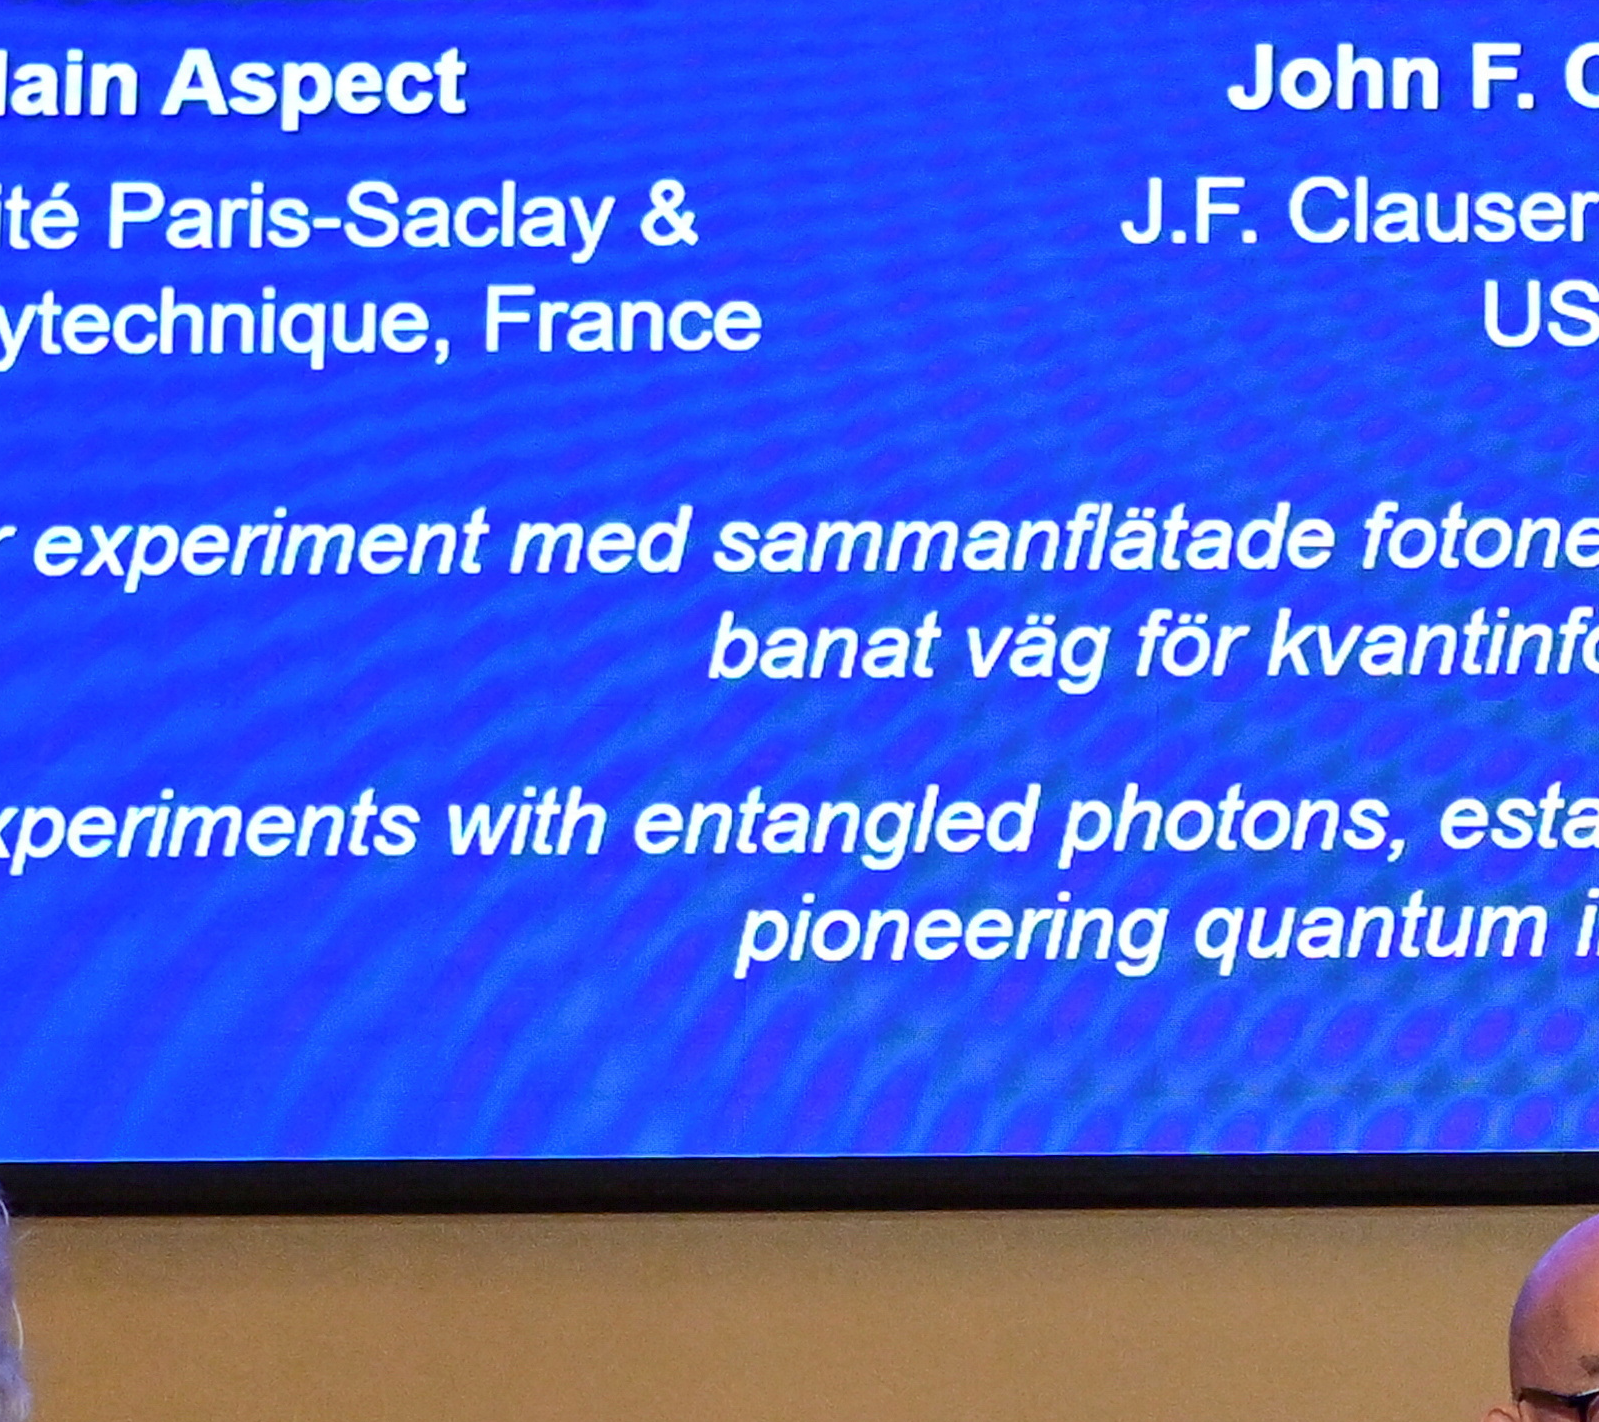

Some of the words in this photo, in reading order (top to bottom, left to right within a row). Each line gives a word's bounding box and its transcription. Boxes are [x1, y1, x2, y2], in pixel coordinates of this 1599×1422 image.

[161, 48, 466, 131] Aspect
[1228, 44, 1438, 109] John
[1473, 43, 1533, 109] F.
[110, 181, 615, 263] Paris-Saclay
[641, 180, 698, 245] &
[1121, 177, 1256, 244] J.F.
[1290, 177, 1599, 242] Clauser
[486, 285, 761, 351] France
[34, 508, 489, 592] experiment
[511, 505, 692, 573] med
[714, 502, 1334, 572] sammanflätade
[709, 611, 941, 678] banat
[968, 615, 1110, 694] väg
[1137, 609, 1250, 676] för
[449, 787, 606, 855] with
[635, 784, 1041, 870] entangled
[1059, 783, 1404, 869] photons,
[735, 891, 1169, 979] pioneering
[1196, 890, 1547, 976] quantum
